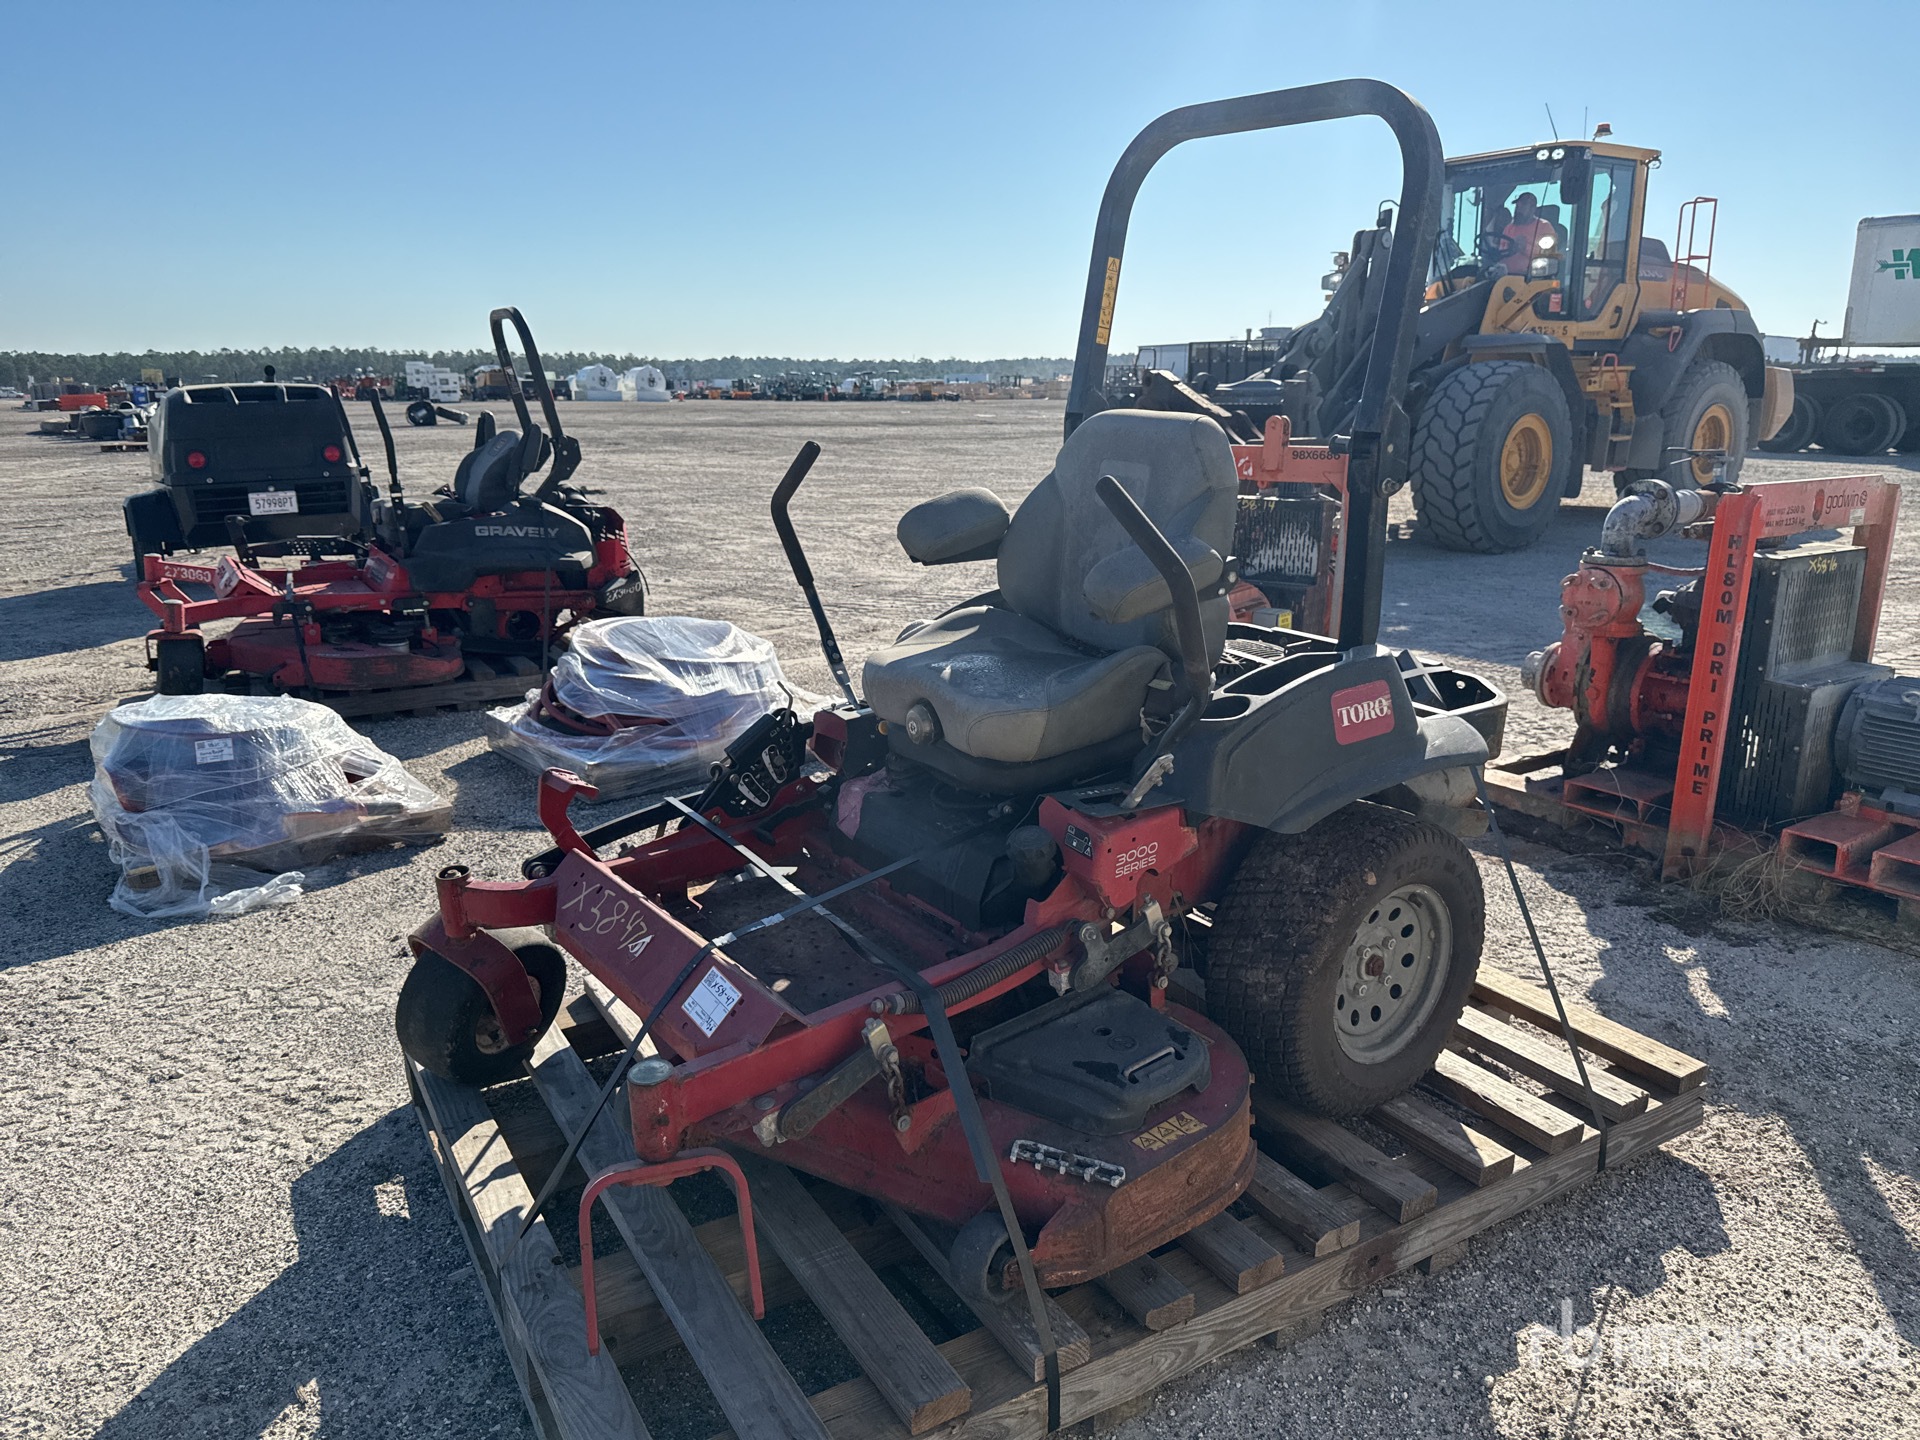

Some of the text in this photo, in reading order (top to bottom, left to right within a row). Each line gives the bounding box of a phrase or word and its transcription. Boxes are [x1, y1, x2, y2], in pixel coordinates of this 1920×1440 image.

[255, 497, 293, 509] 57998PT
[1825, 489, 1859, 514] godwin
[475, 526, 559, 538] GRAVELY
[1708, 642, 1726, 693] DRI
[1337, 697, 1388, 727] TORO
[1692, 711, 1716, 795] PRIME
[1115, 855, 1157, 878] SERIES
[1116, 842, 1158, 867] 3000
[711, 980, 735, 1007] X58-47
